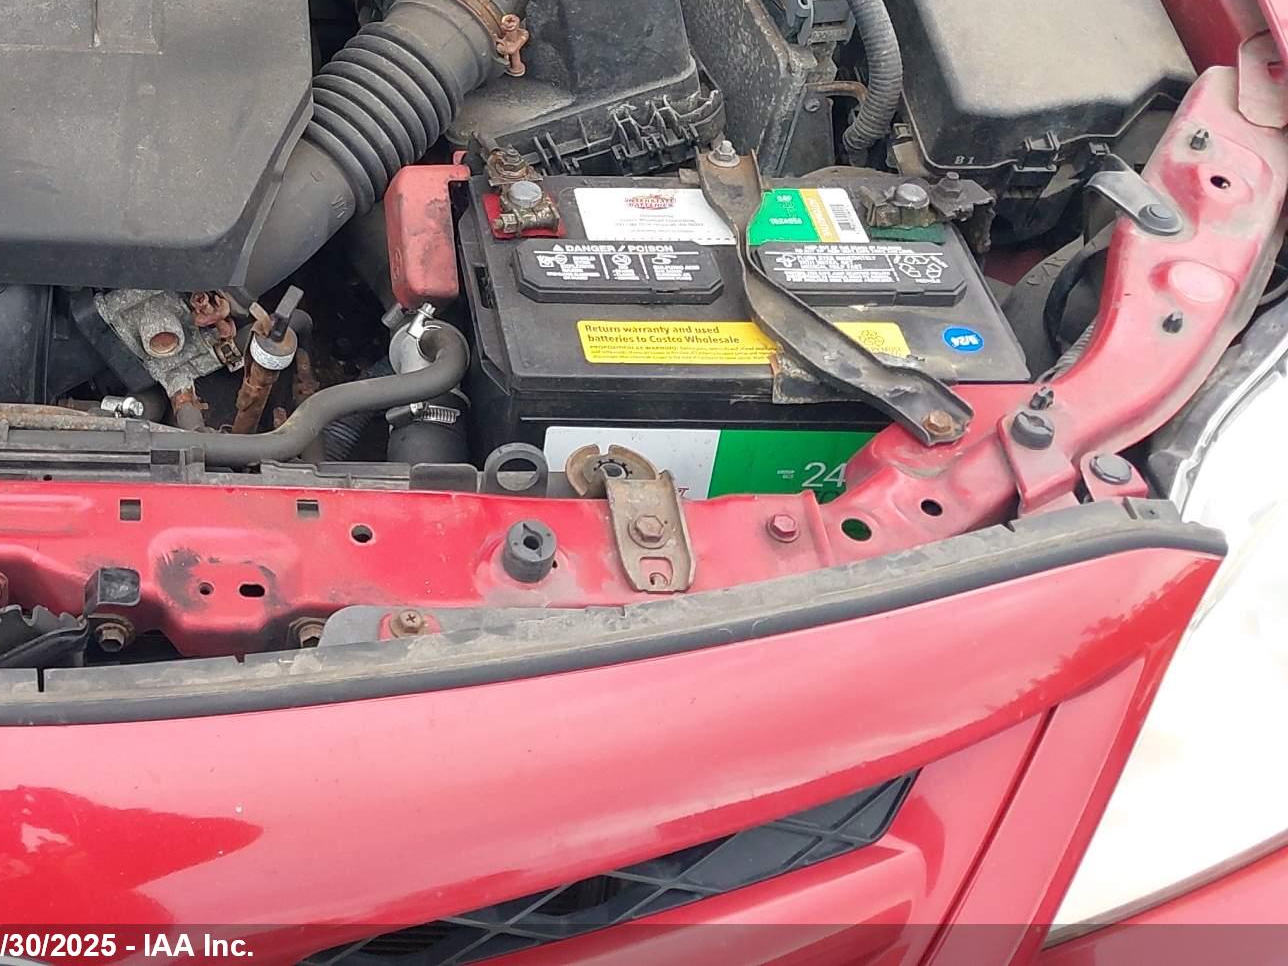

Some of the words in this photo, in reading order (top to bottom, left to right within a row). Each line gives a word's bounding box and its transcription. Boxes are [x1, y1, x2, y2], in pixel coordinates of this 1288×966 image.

[565, 245, 616, 253] DANGER
[628, 245, 674, 253] POISON
[585, 324, 621, 333] Return
[623, 325, 670, 335] warranty
[672, 326, 692, 334] and
[695, 326, 720, 334] used
[587, 335, 634, 343] batteries
[685, 336, 740, 344] Wholesale
[801, 462, 848, 488] 24
